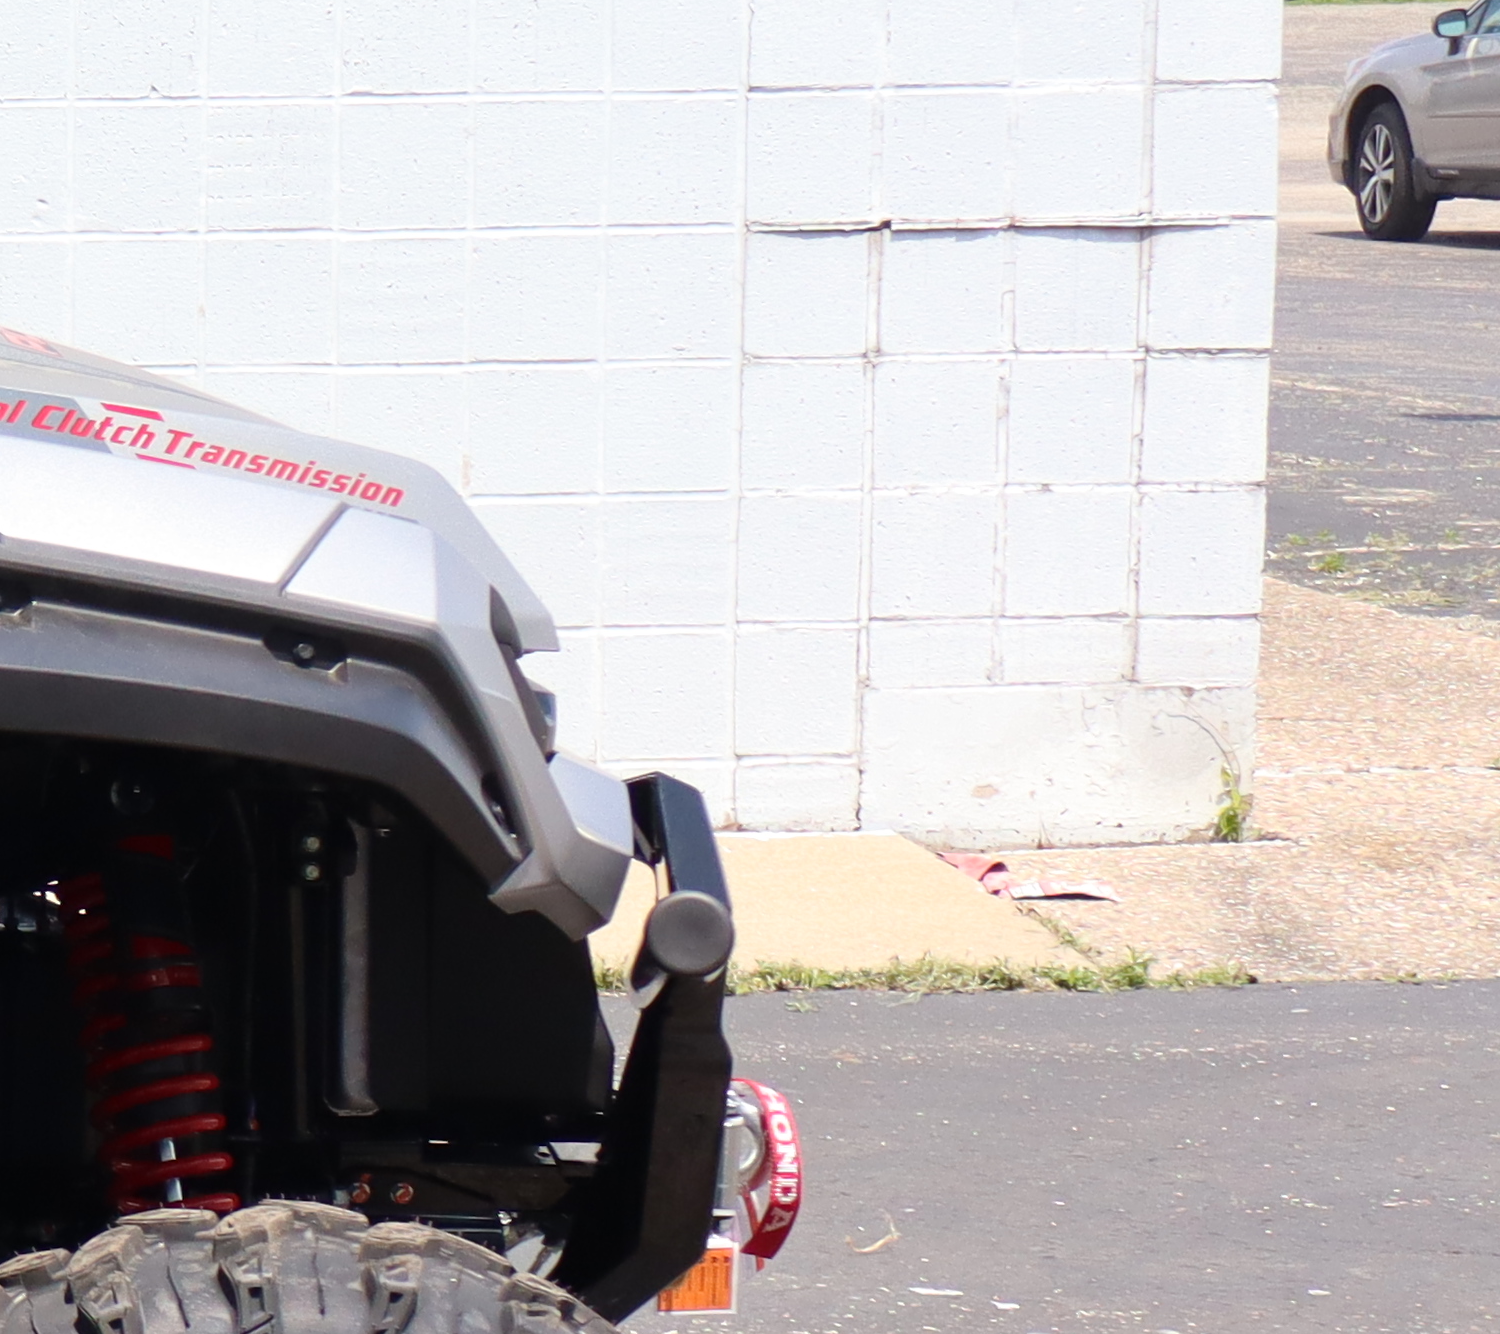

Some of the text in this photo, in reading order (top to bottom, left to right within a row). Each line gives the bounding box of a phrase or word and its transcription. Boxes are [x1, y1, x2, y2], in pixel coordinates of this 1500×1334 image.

[31, 404, 155, 450] Clutch
[164, 429, 405, 507] Transmission
[759, 1086, 798, 1232] HONDA
